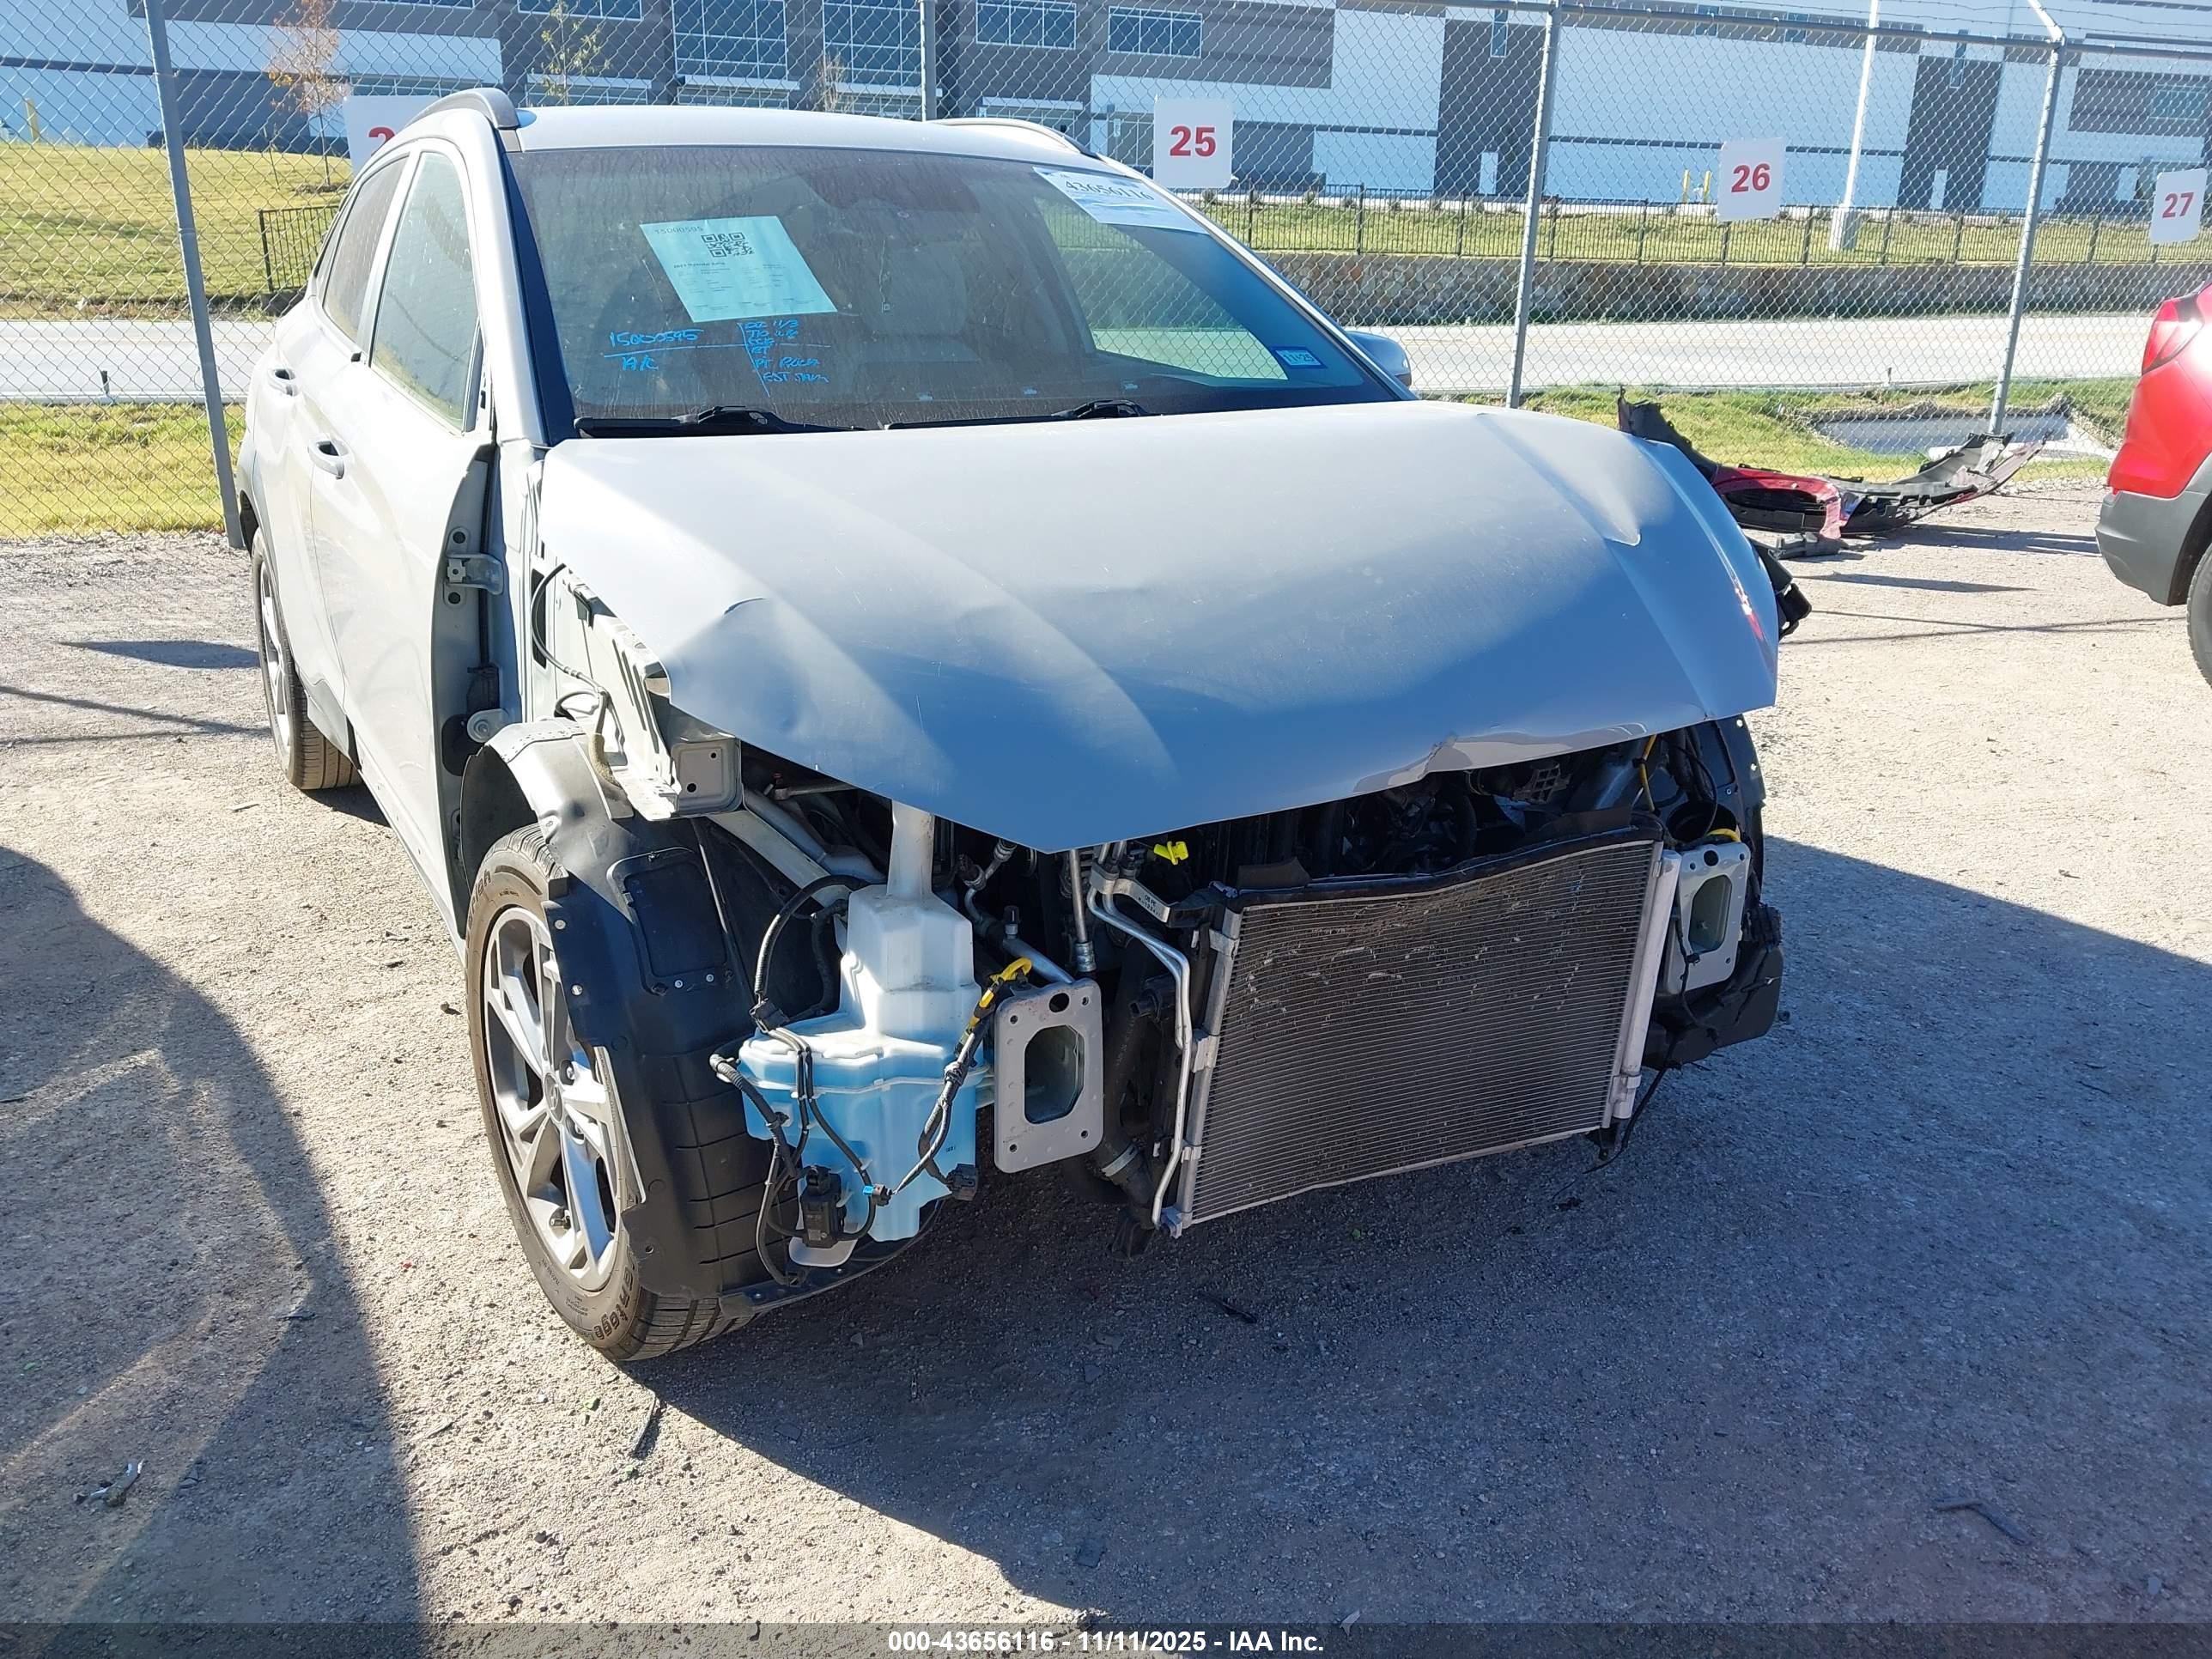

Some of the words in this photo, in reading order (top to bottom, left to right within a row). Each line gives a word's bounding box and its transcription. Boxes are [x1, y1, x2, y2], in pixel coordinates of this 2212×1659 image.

[1170, 125, 1216, 156] 25
[1065, 180, 1155, 200] 43656116
[1731, 163, 1770, 192] 26
[2162, 192, 2194, 217] 27
